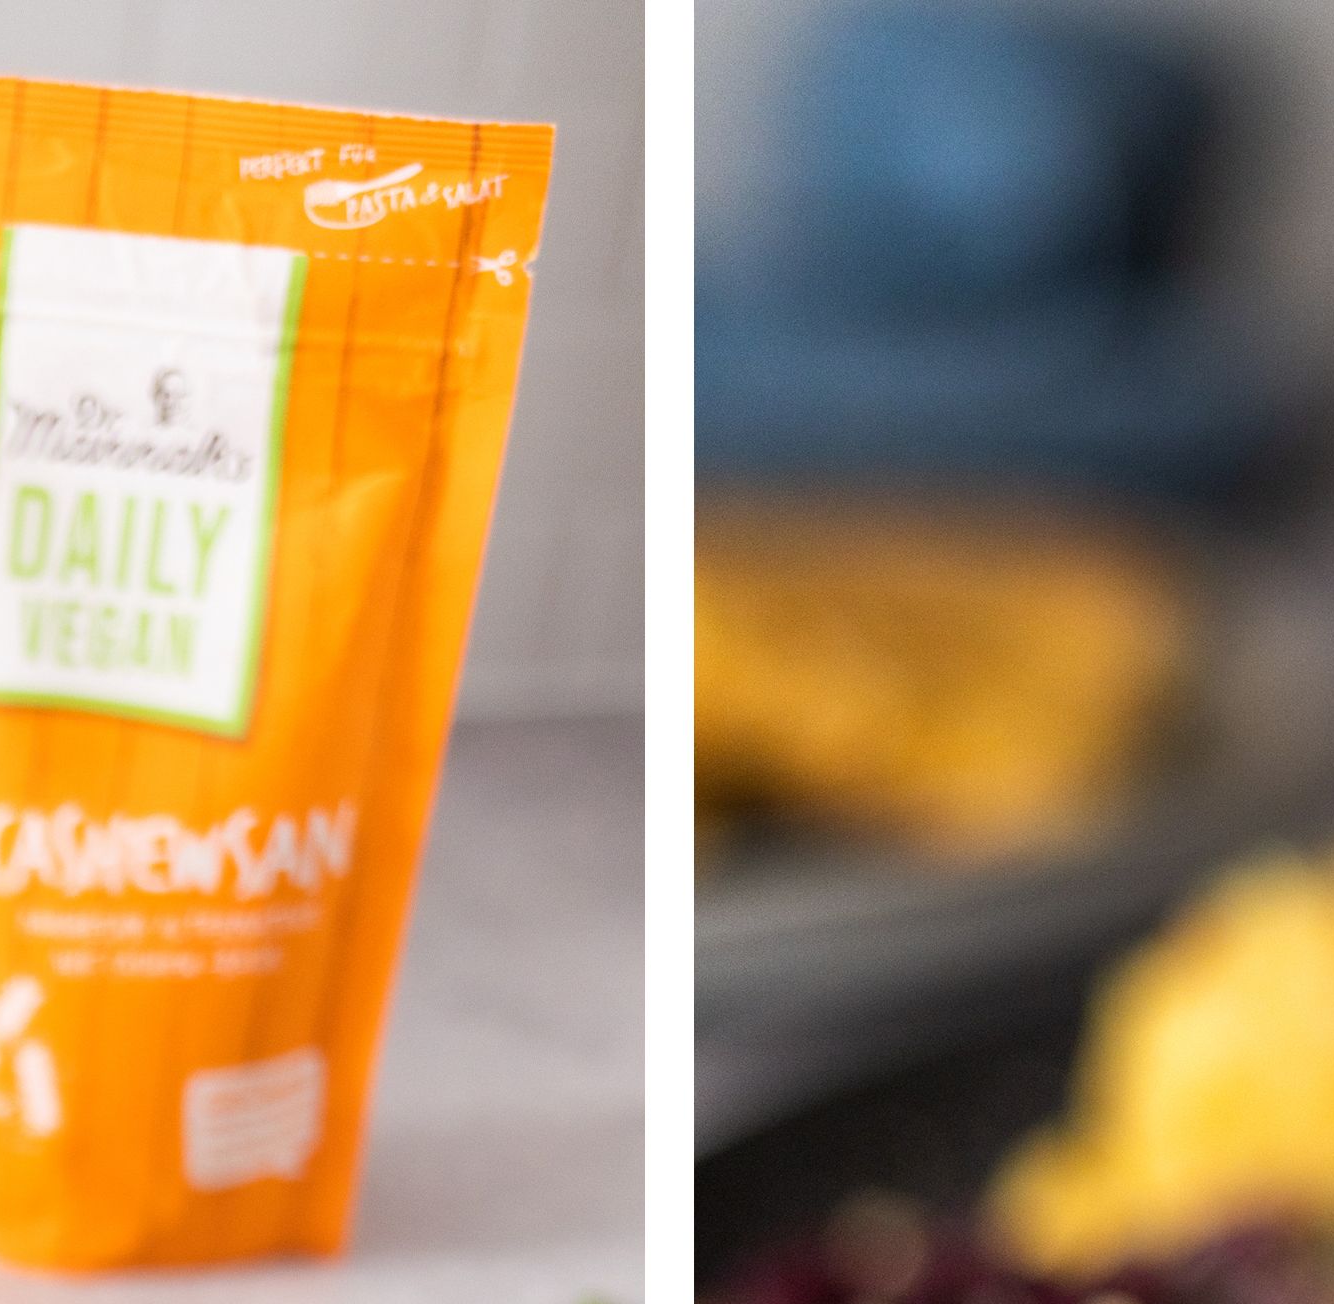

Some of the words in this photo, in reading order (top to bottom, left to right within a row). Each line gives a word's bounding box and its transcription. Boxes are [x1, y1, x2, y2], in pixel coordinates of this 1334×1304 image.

[345, 185, 417, 223] PASTA
[442, 174, 511, 210] SALAT
[8, 484, 234, 600] DAILY
[22, 600, 200, 674] VEGAN
